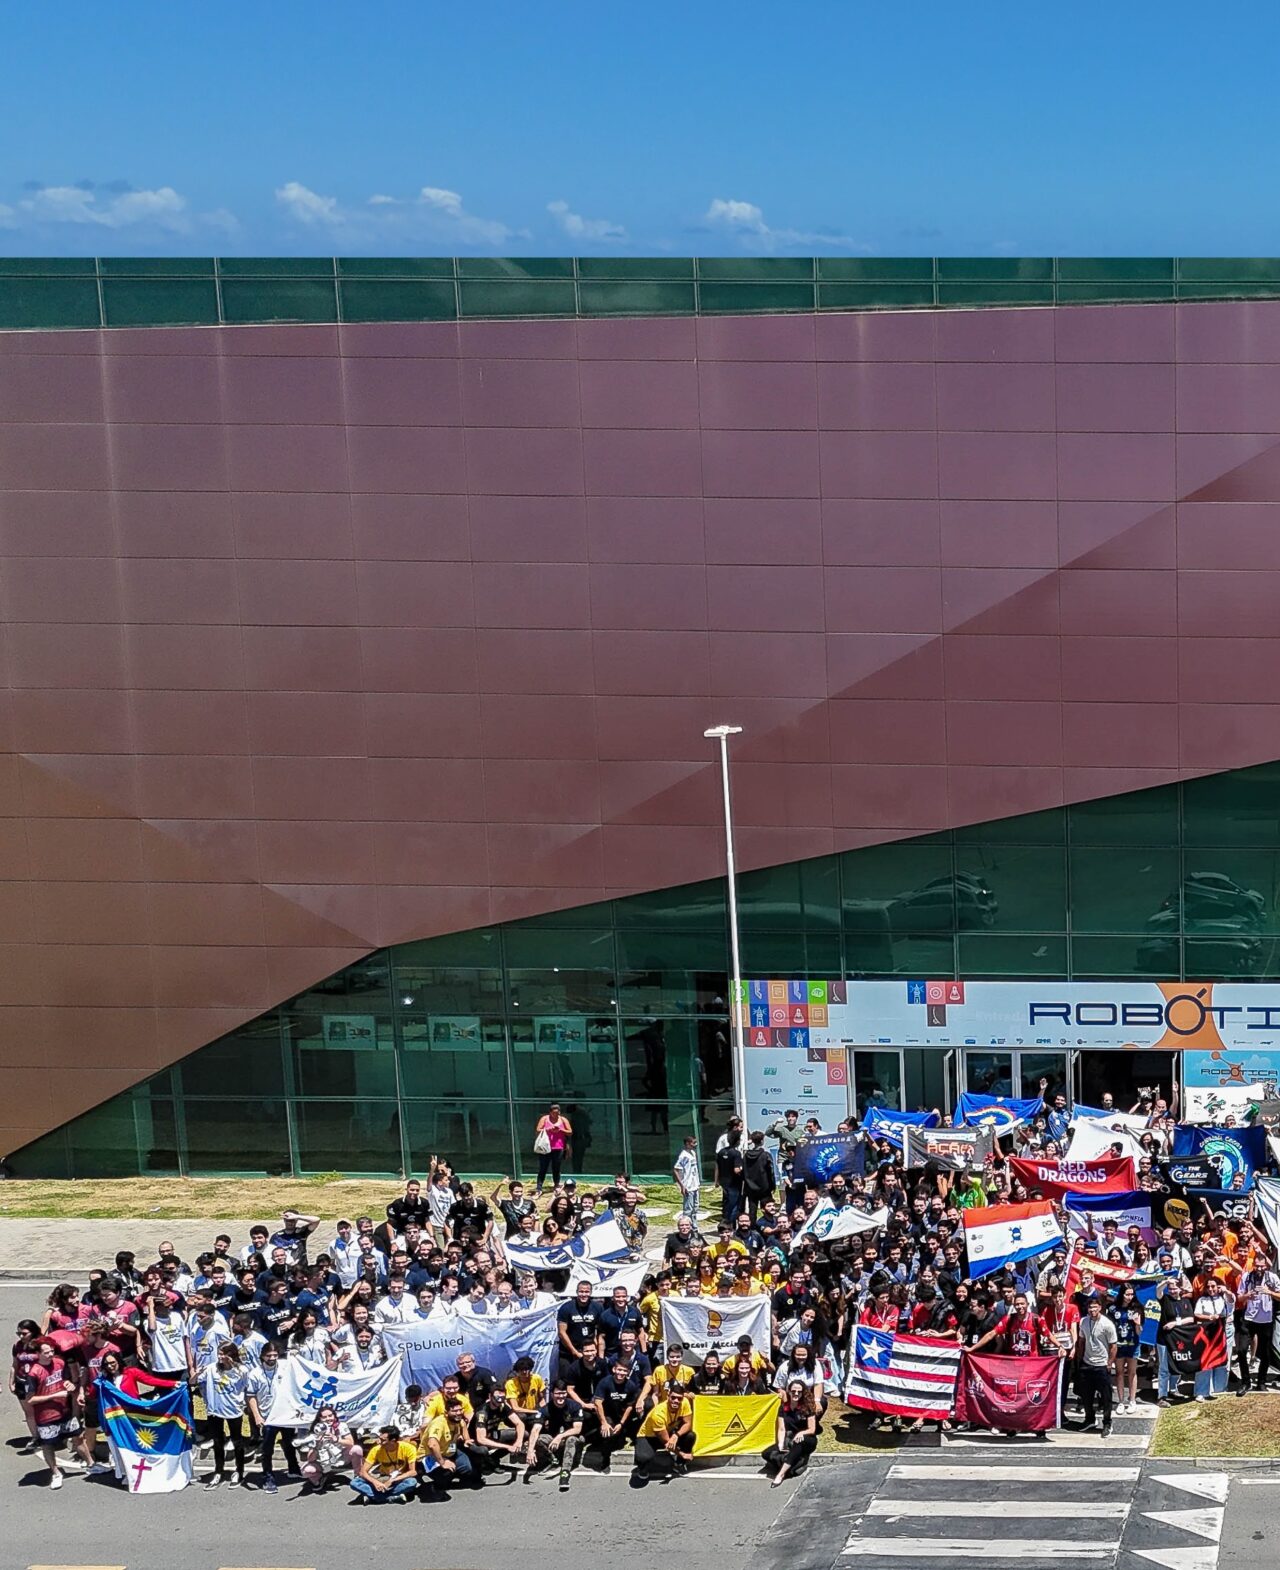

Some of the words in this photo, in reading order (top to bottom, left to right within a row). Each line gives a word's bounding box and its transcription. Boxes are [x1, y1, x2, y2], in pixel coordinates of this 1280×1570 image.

[1057, 1159, 1087, 1172] RED
[1037, 1166, 1107, 1183] DRAGONS
[397, 1335, 465, 1353] SPbUnited
